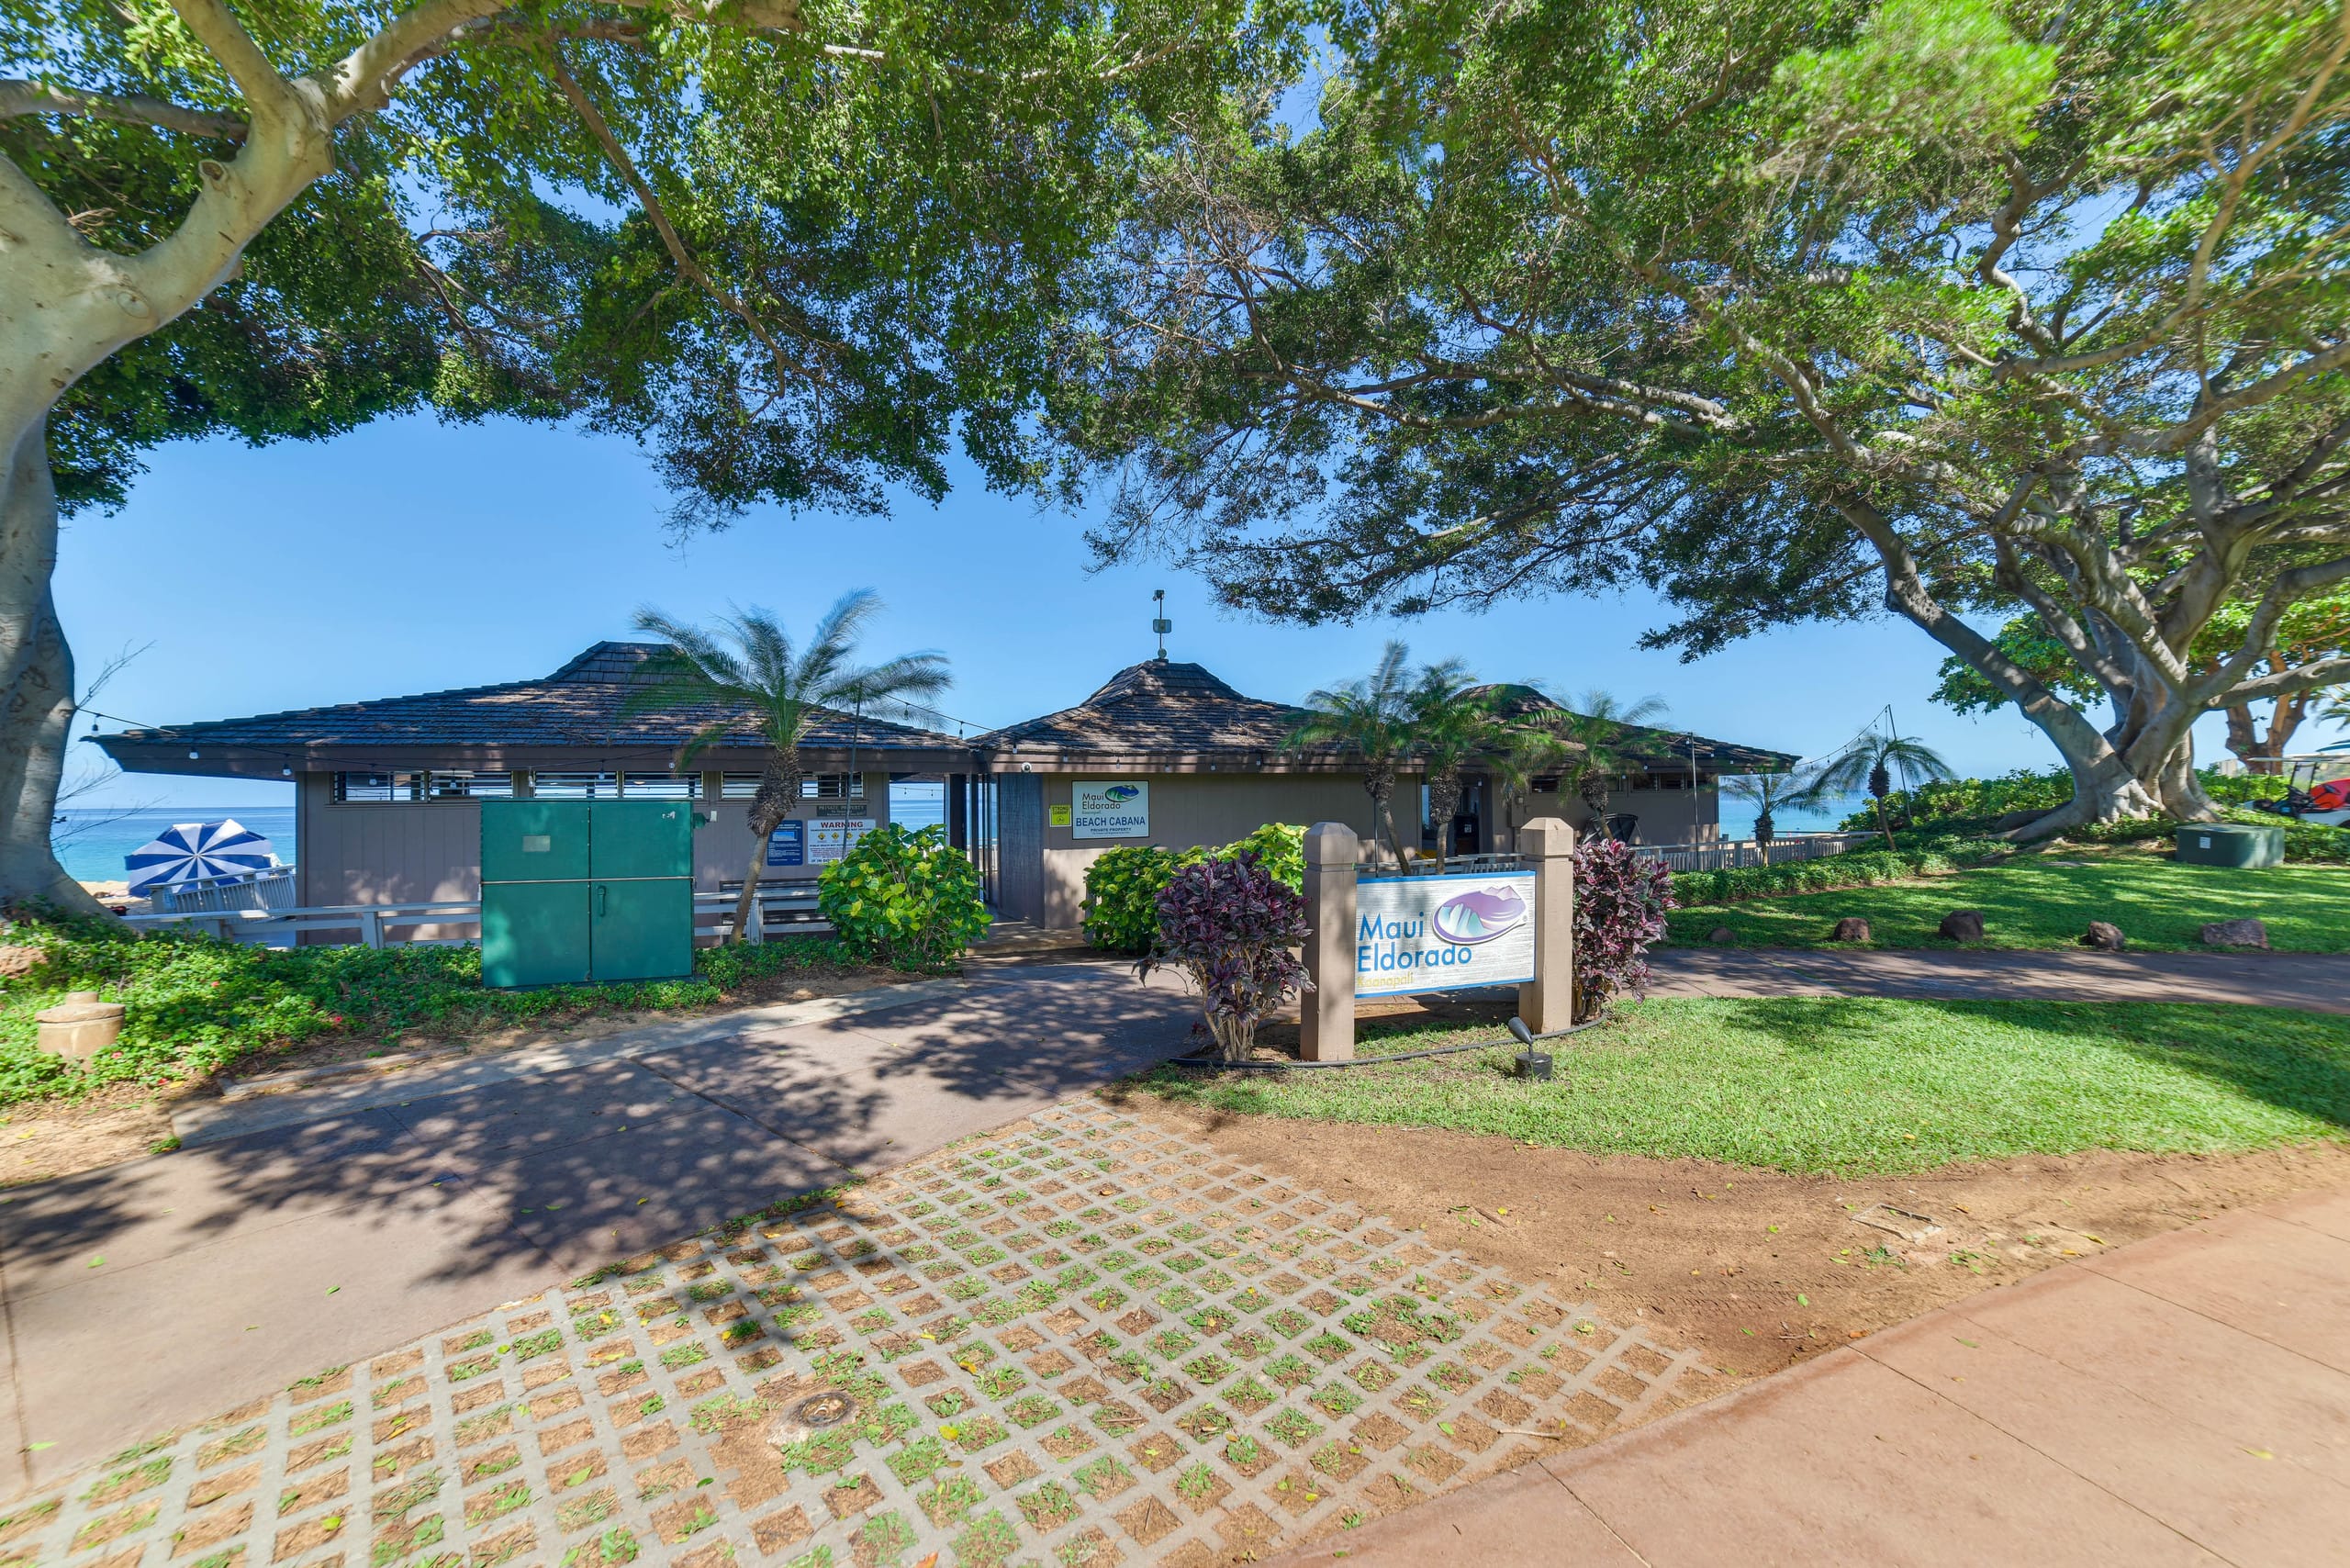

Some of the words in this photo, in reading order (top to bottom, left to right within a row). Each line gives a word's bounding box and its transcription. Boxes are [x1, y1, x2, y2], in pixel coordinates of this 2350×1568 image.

[1082, 792, 1104, 801] Maui
[1082, 801, 1121, 810] Eldorado
[1076, 817, 1107, 826] BEACH
[1109, 816, 1146, 826] CABANA
[1359, 912, 1424, 941] Maui
[1358, 942, 1472, 972] Eldorado
[1357, 971, 1414, 988] Kaanapali
